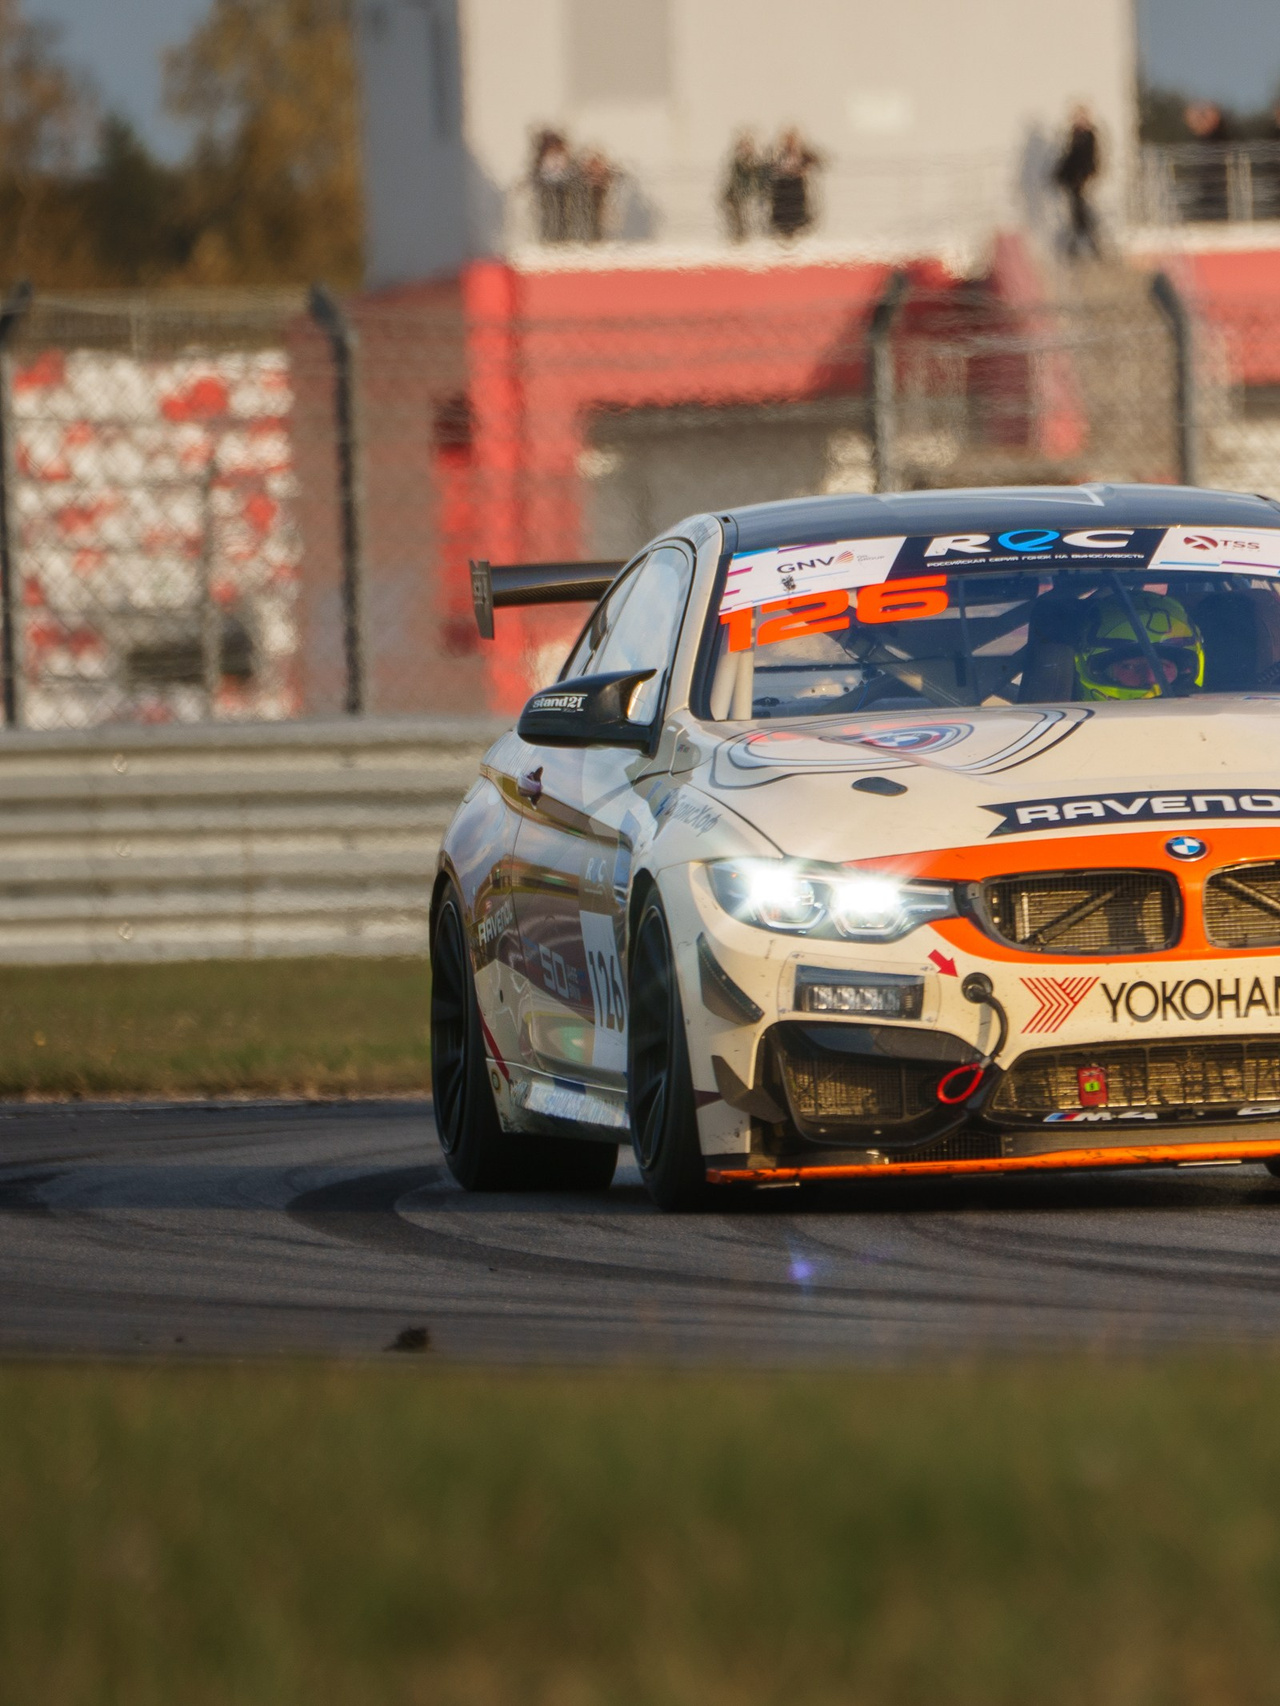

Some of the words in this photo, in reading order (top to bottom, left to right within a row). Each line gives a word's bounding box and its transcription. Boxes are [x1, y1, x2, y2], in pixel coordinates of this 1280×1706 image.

[1219, 539, 1261, 550] TSS
[776, 556, 835, 574] GNV
[926, 557, 986, 568] РОССИЙСКАЯ
[988, 555, 1019, 563] СЕРИЯ
[1021, 554, 1052, 562] ГОНОК
[719, 573, 949, 653] 126
[532, 696, 583, 709] stand21
[588, 950, 625, 1033] 126
